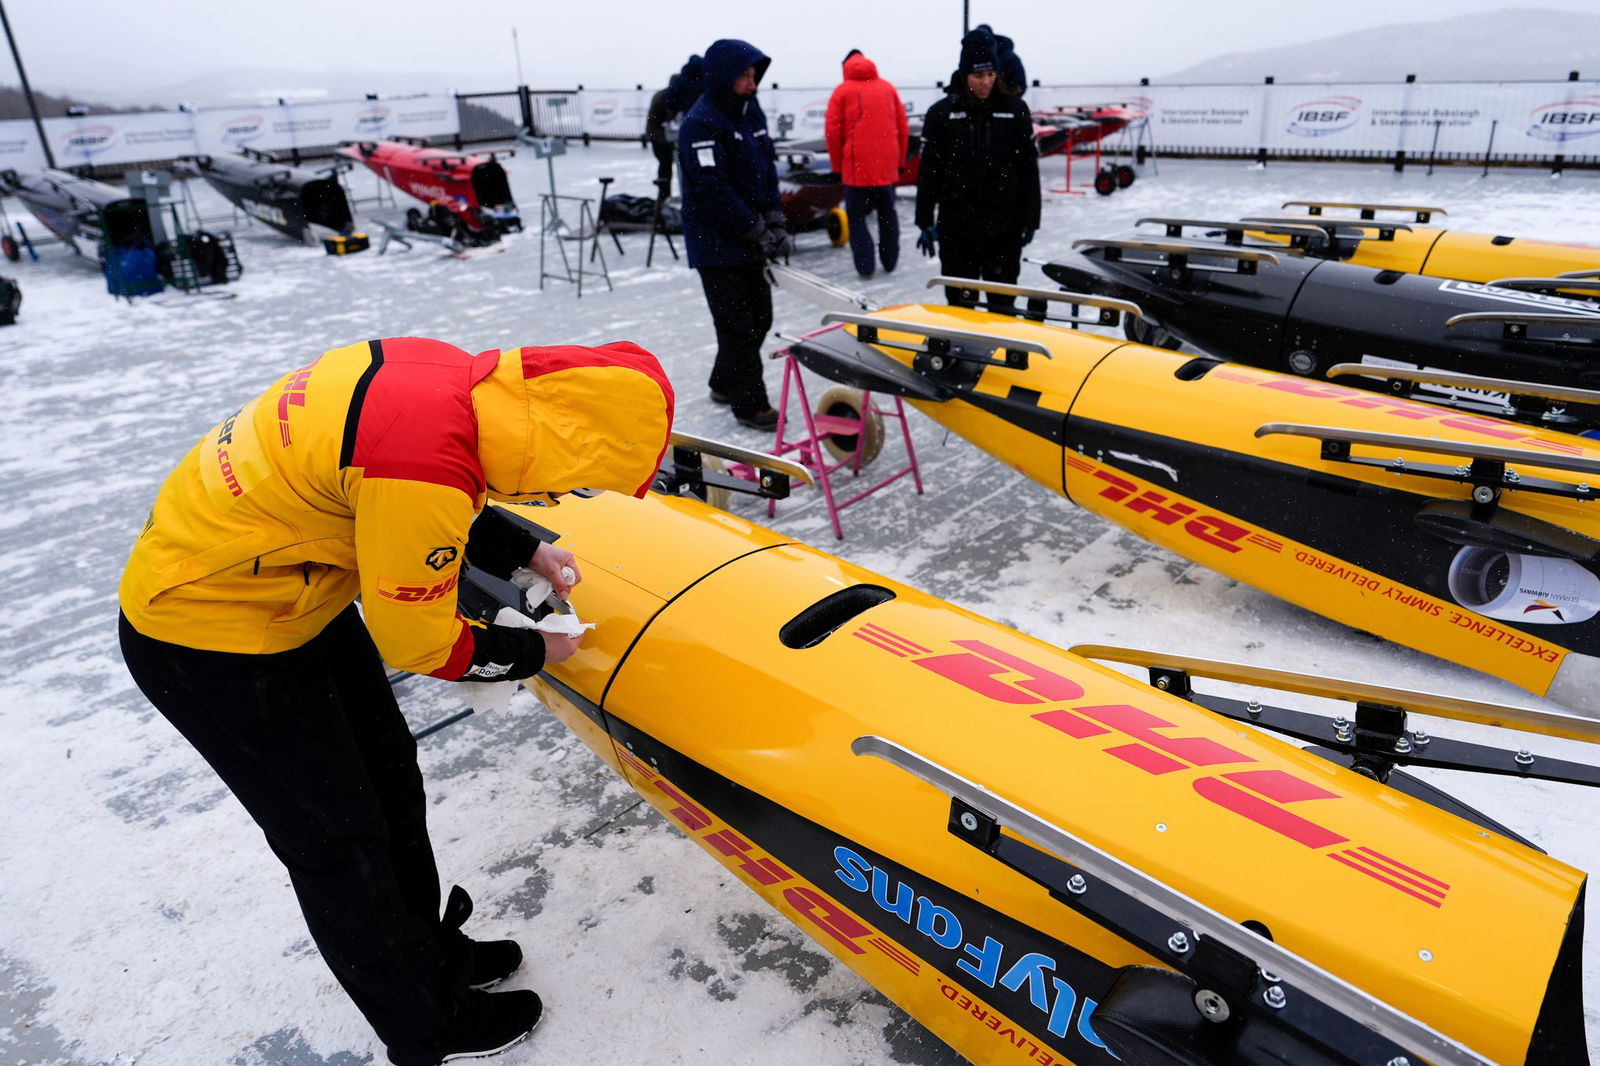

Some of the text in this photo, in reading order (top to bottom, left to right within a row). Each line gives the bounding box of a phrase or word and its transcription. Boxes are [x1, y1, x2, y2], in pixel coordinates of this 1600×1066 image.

[1298, 111, 1350, 122] IBSF
[1371, 109, 1429, 117] International
[1257, 378, 1527, 441] DHL
[1090, 469, 1254, 554] DHL
[1294, 549, 1560, 663] EXCELLENCE. SIMPLY DELIVERED.
[1519, 588, 1549, 598] AIRWAYS
[911, 639, 1350, 850] DHL
[652, 780, 874, 955] DHL
